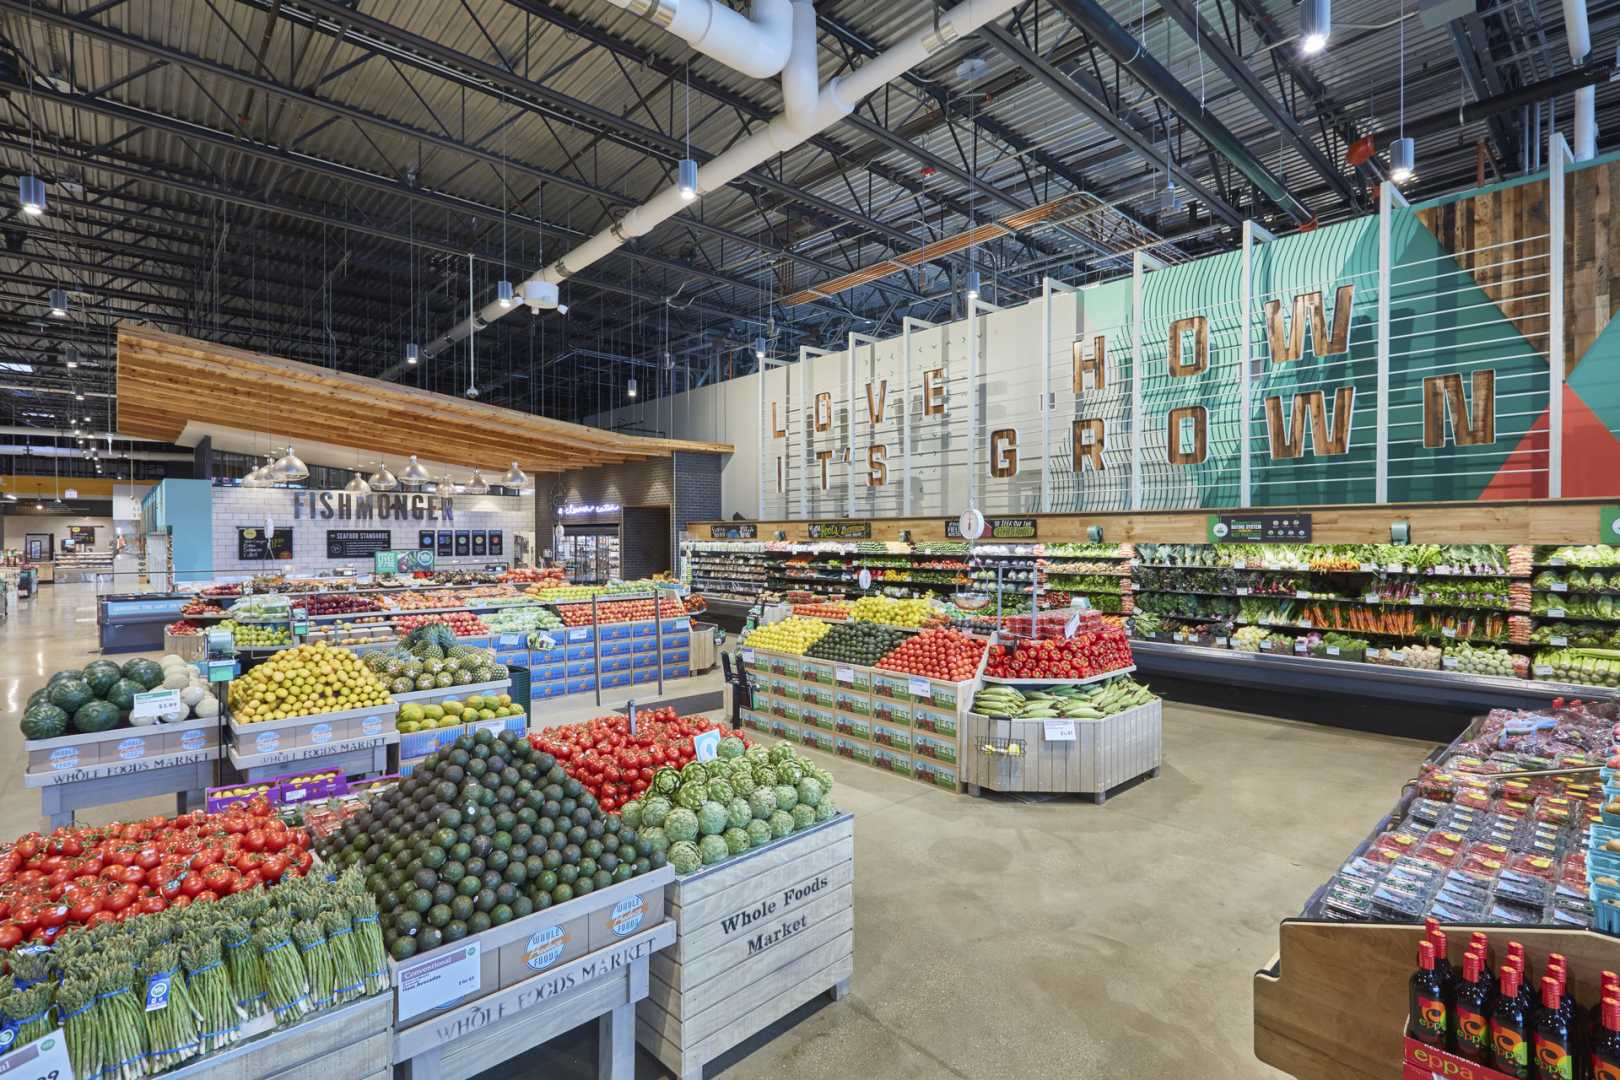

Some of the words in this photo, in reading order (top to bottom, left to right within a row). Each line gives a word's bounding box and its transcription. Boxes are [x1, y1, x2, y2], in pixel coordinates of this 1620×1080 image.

[771, 367, 946, 440] LOVE
[1072, 284, 1356, 395] HOW
[776, 443, 889, 495] IT'S
[989, 368, 1497, 479] GROWN
[293, 491, 454, 521] FISHMONGER
[720, 900, 776, 935] Whole
[783, 877, 828, 907] Foods
[747, 914, 808, 956] Market
[435, 1003, 506, 1042] WHOLE
[517, 971, 576, 1011] FOODS
[581, 936, 657, 981] MARKET
[1413, 1048, 1473, 1080] eppa
